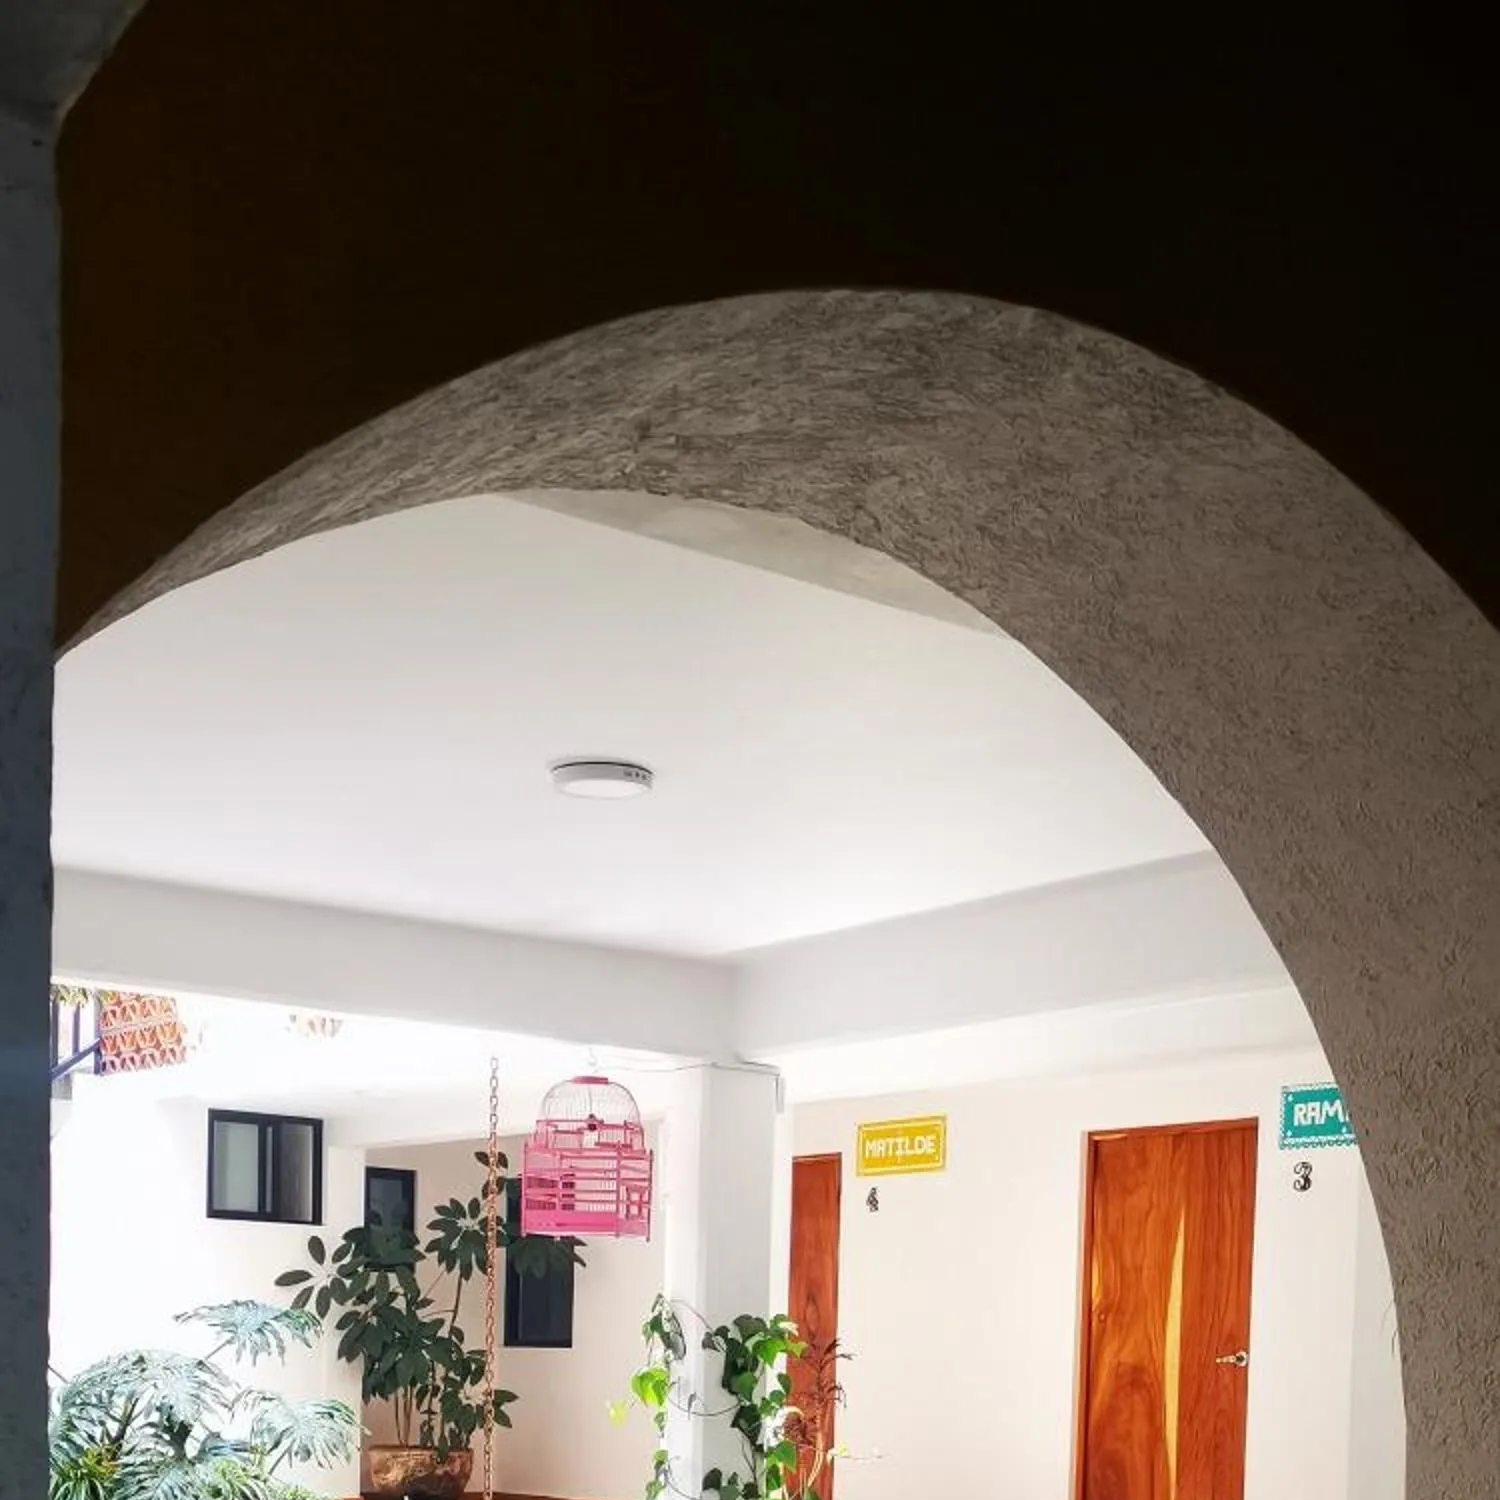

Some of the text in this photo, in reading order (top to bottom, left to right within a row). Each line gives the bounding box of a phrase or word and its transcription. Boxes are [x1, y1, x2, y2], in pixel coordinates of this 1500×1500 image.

[1293, 1099, 1349, 1126] RAM
[865, 1135, 937, 1158] MATILDE
[1293, 1161, 1312, 1192] 3
[866, 1187, 879, 1212] 4
